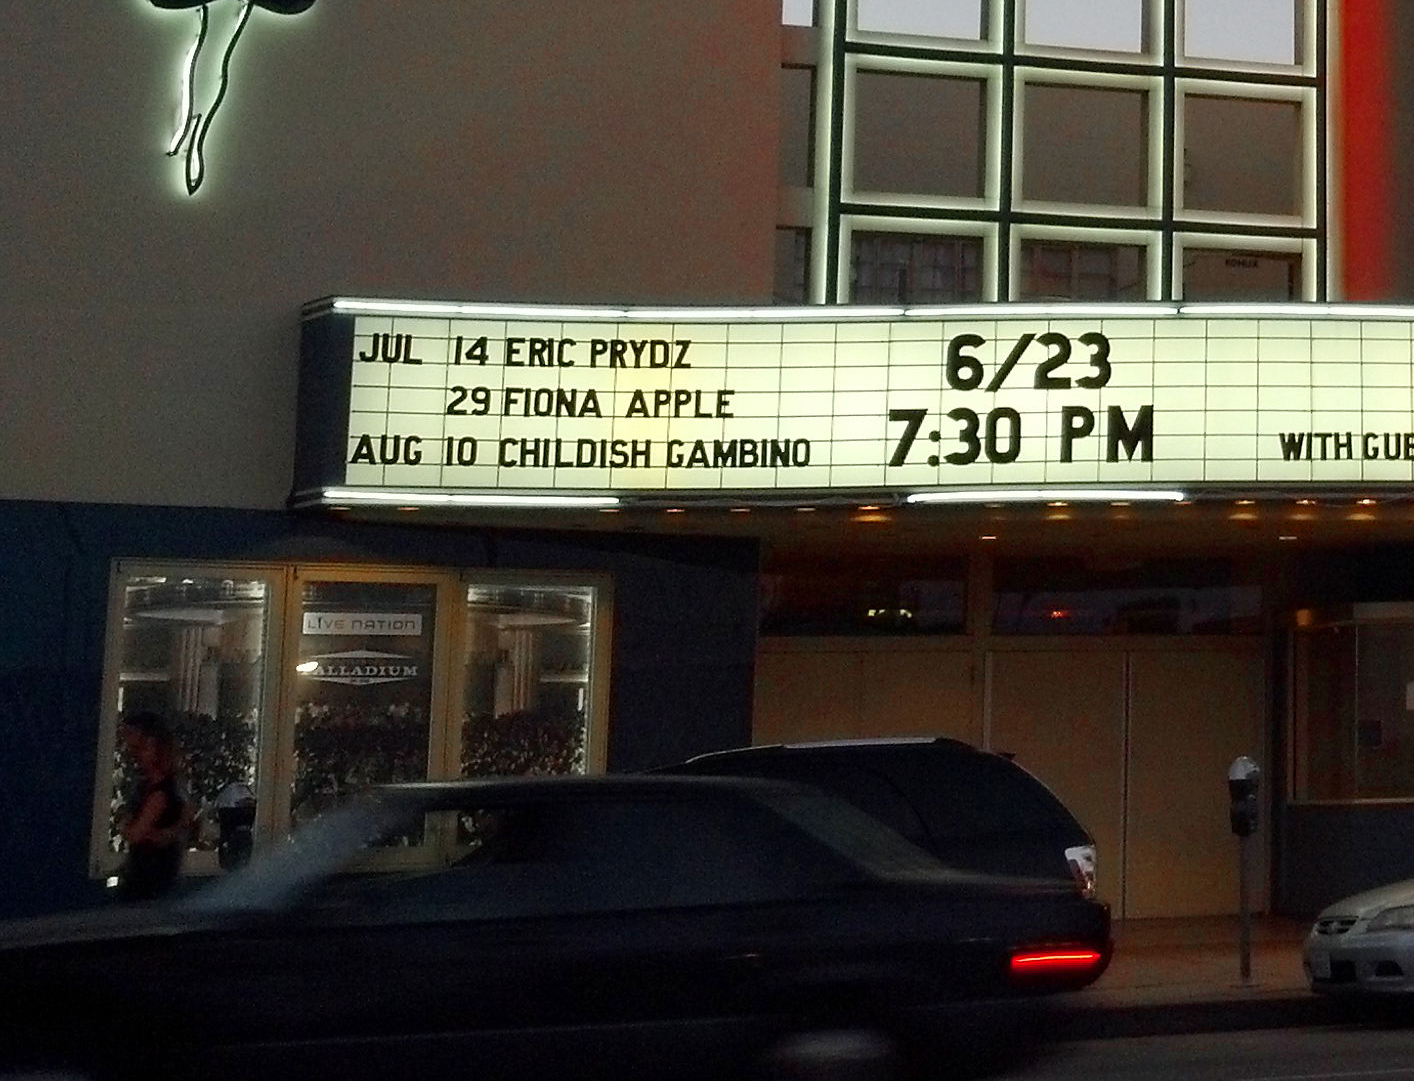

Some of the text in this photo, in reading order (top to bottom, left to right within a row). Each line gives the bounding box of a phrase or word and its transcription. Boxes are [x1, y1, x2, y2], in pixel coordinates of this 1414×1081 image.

[359, 333, 692, 369] JUL 14 ERIC PRYDZ
[945, 331, 1112, 393] 6/23
[446, 386, 735, 419] 29 FIONA APPLE
[349, 435, 810, 469] AUG 10 CHILDISH GAMBINO
[888, 404, 1155, 468] 7:30 PM
[1279, 432, 1352, 462] WITH
[302, 665, 418, 676] ALLADIUM
